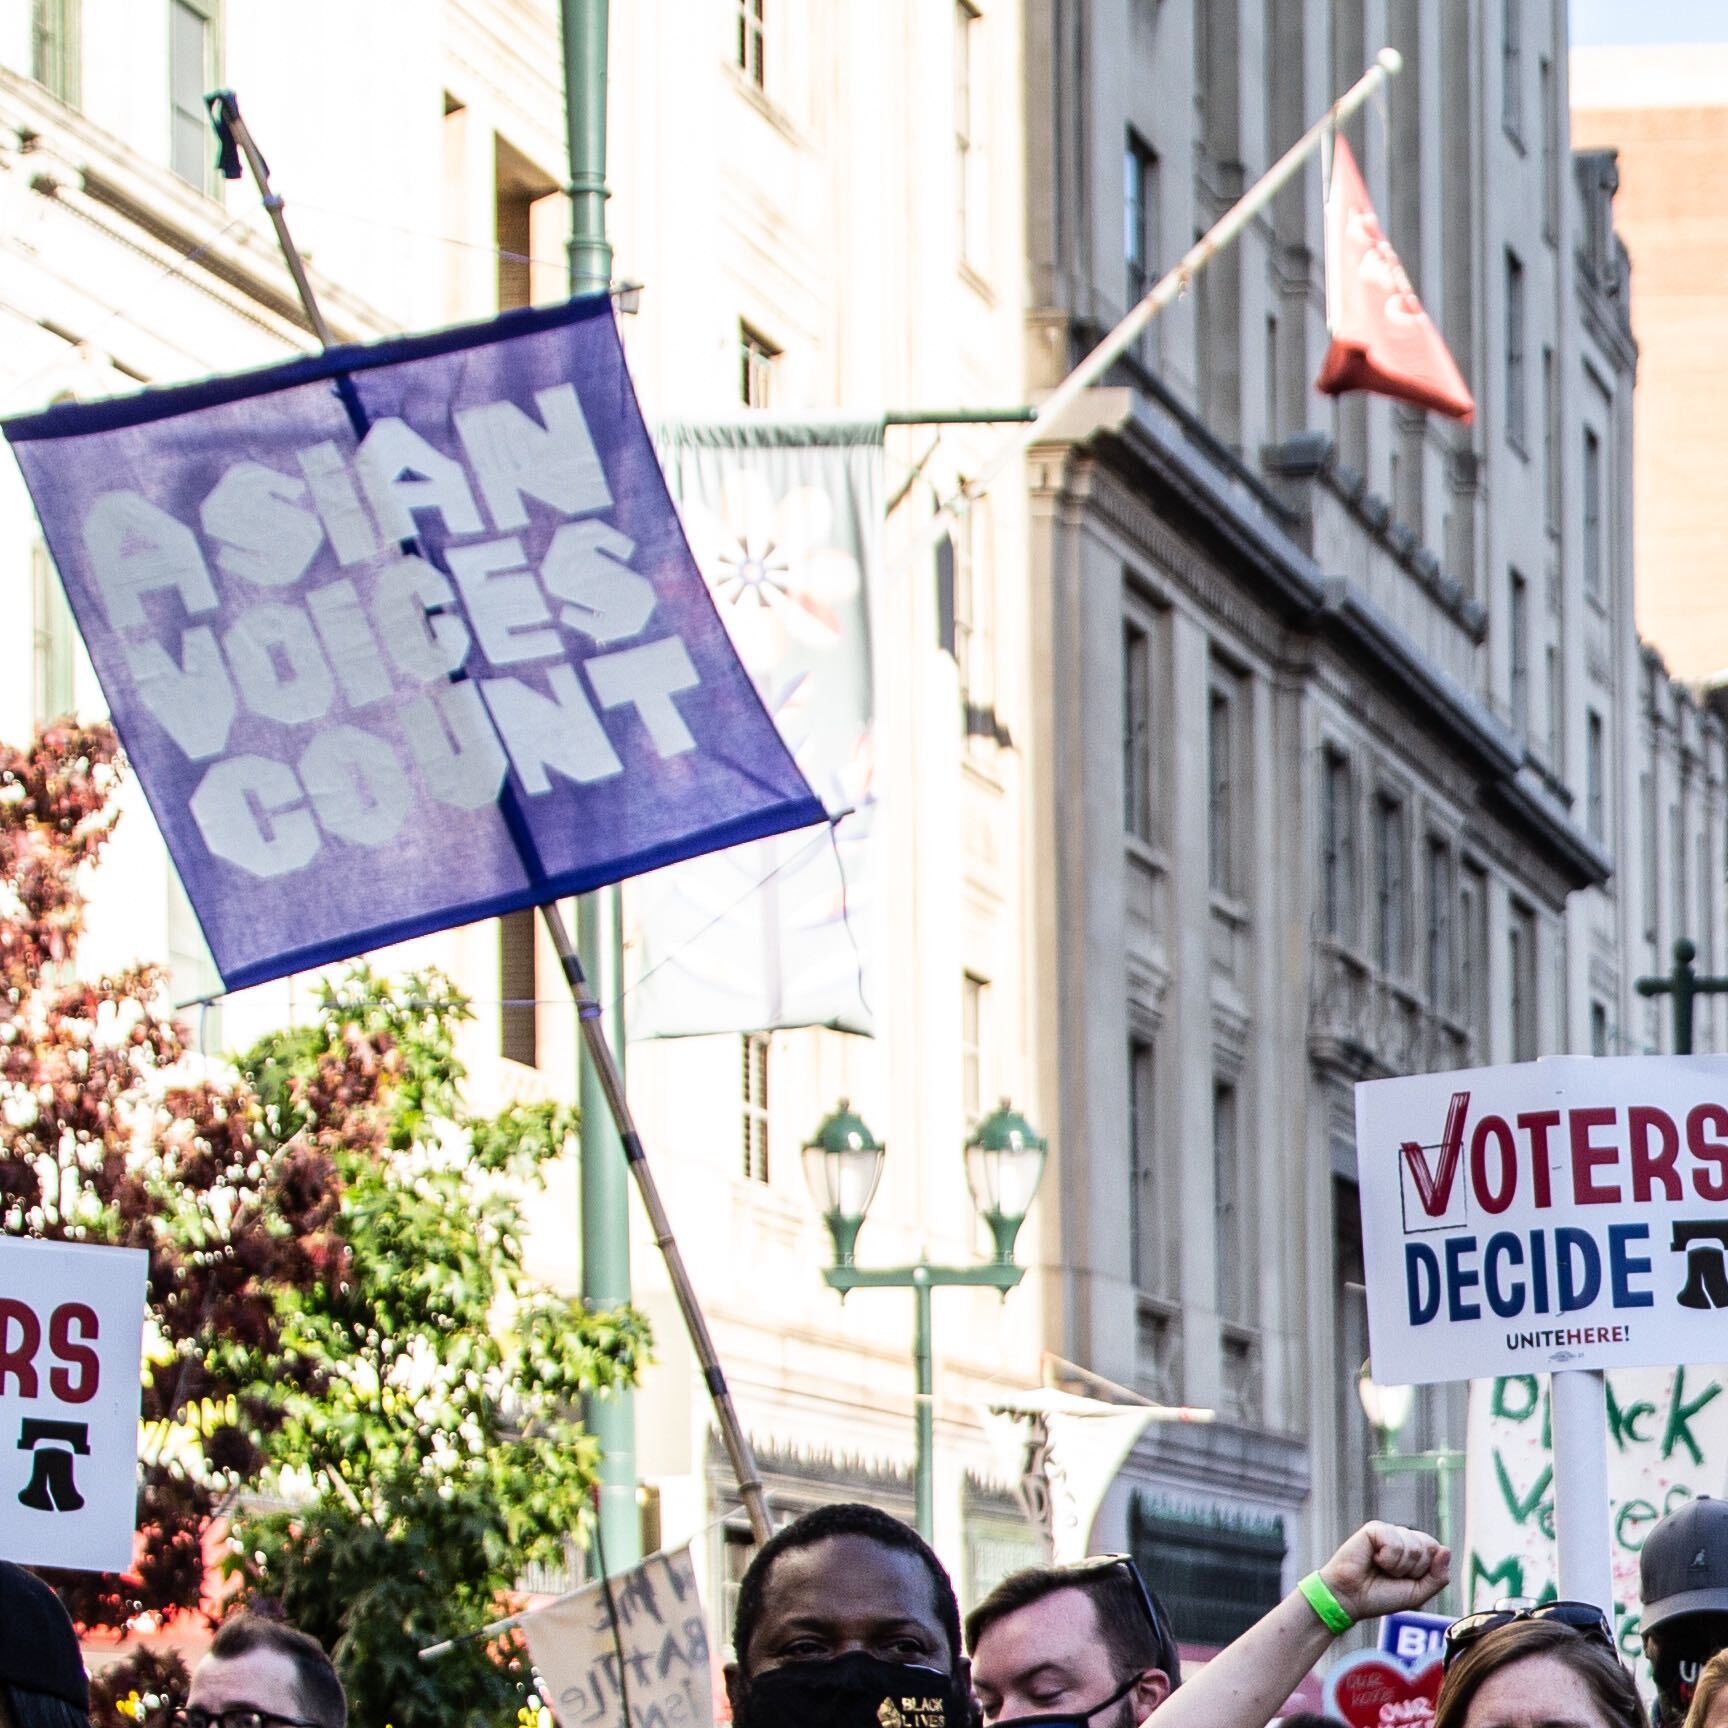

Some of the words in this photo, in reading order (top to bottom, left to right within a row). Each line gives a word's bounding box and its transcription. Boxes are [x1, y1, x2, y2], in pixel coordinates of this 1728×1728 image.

[83, 383, 613, 629] ASIAN
[127, 520, 658, 760] VOICES
[190, 636, 700, 878] COUNT
[1405, 1223, 1655, 1326] DECIDE
[1507, 1326, 1630, 1350] UNITEHERE!
[901, 1697, 943, 1711] BLACK
[901, 1714, 945, 1728] LIVES
